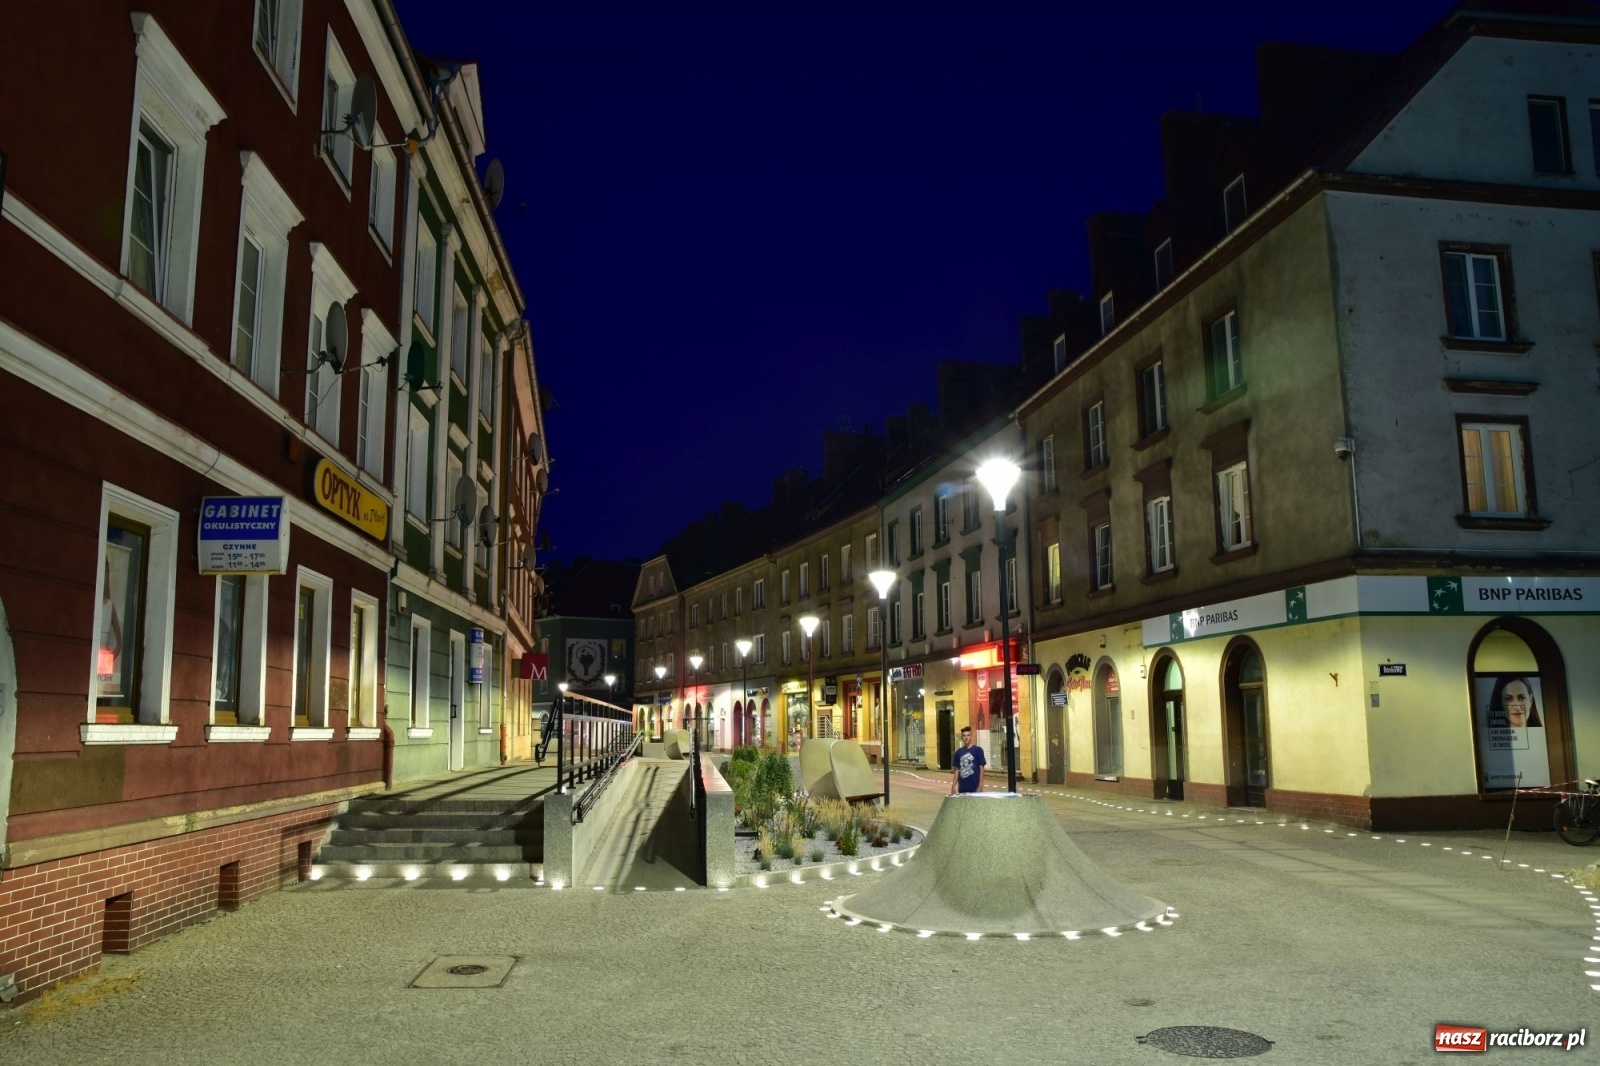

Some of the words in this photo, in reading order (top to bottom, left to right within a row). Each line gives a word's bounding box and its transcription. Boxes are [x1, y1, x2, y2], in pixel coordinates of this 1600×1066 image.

[321, 466, 361, 521] OPTYK
[204, 504, 280, 518] GABINET
[203, 522, 276, 530] OKULISTYCZNY
[1479, 587, 1512, 601] BNP
[1516, 587, 1583, 601] PARIBAS
[1206, 609, 1239, 626] PARIBAS
[530, 662, 548, 681] M
